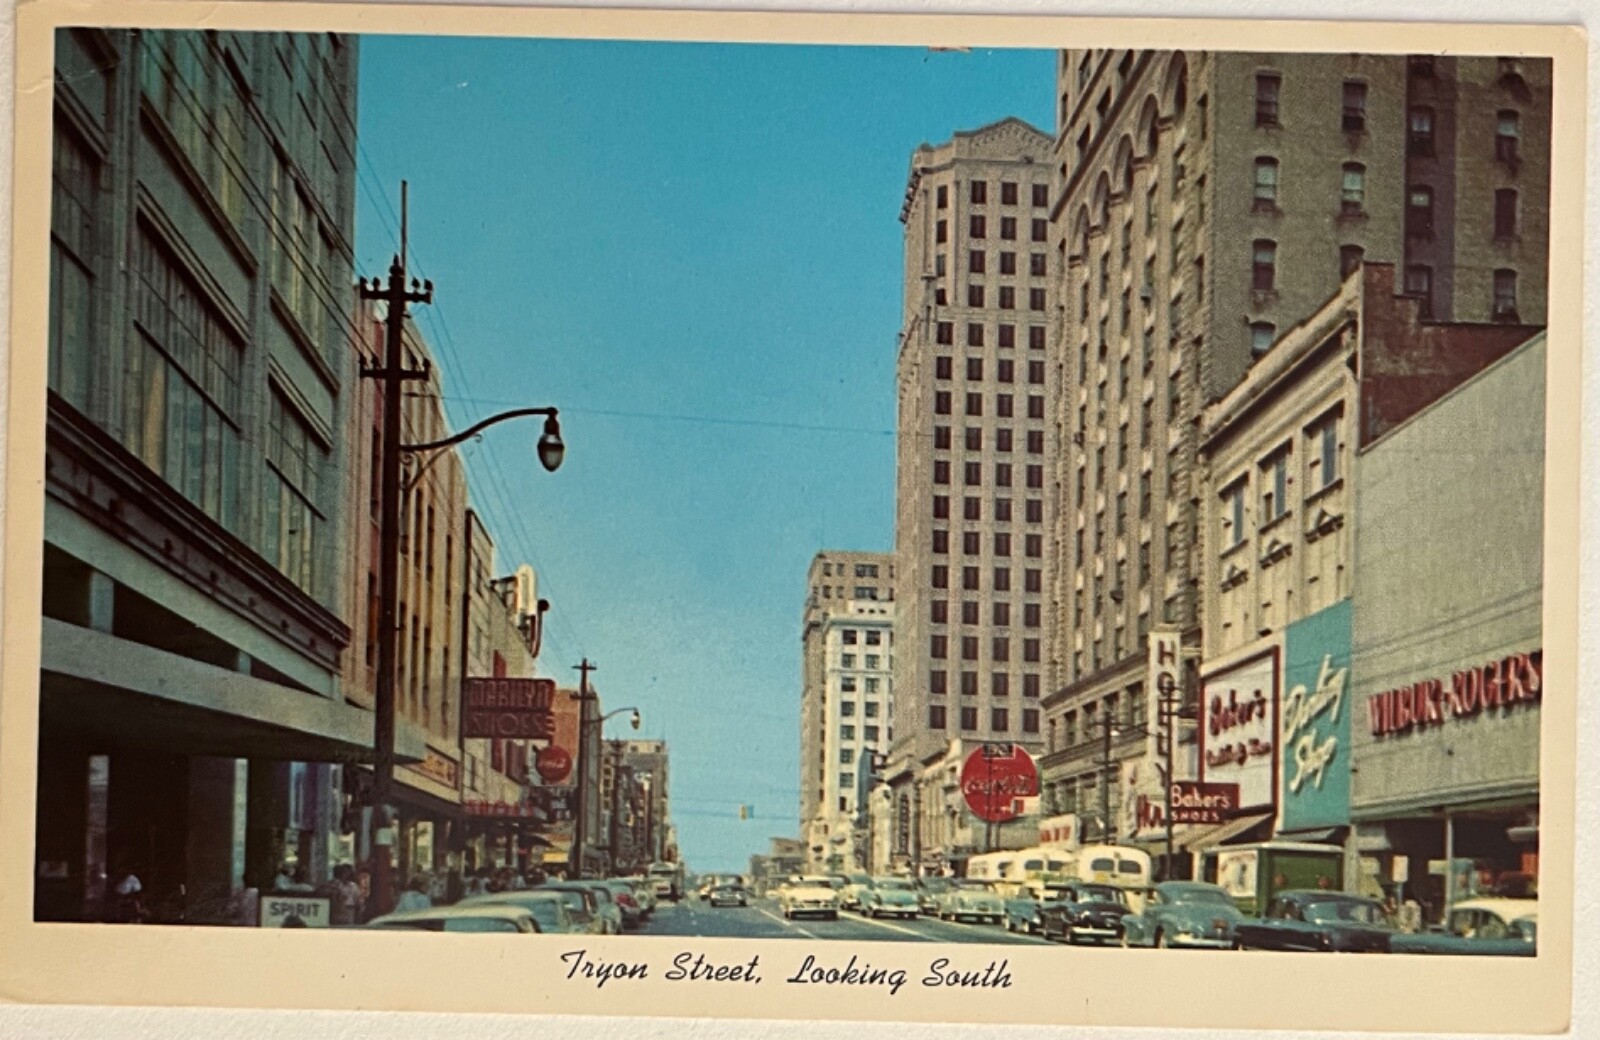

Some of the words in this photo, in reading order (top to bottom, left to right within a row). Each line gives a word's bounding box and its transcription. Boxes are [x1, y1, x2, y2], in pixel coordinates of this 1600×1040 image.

[1170, 784, 1231, 809] Baker's
[1170, 810, 1220, 822] SHOES
[269, 901, 321, 917] SPIRIT
[560, 950, 648, 989] Tryon
[665, 952, 763, 984] Street,
[786, 954, 908, 996] Looking
[921, 957, 1013, 988] South
